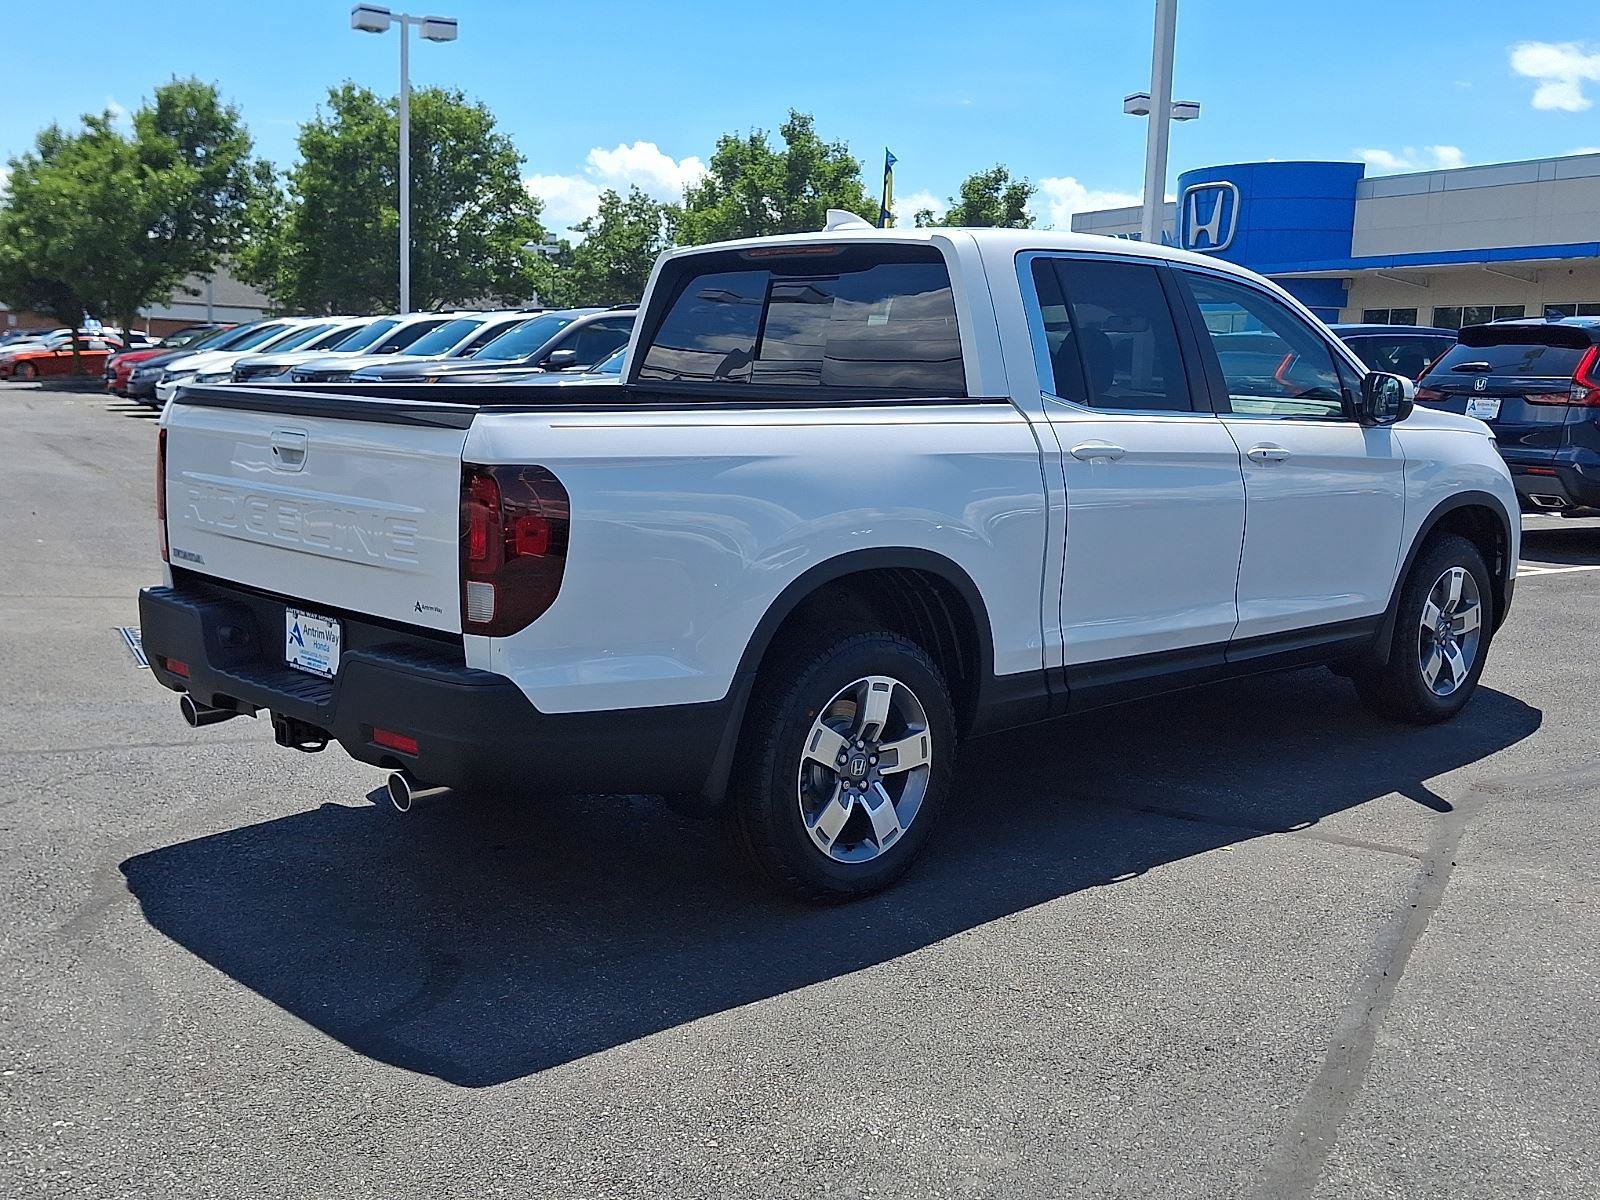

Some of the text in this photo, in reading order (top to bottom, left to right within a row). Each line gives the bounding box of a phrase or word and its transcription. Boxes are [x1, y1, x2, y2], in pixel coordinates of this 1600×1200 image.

[183, 482, 419, 565] RIDGELINE
[303, 624, 340, 647] Antrim Way
[313, 640, 330, 653] Honda
